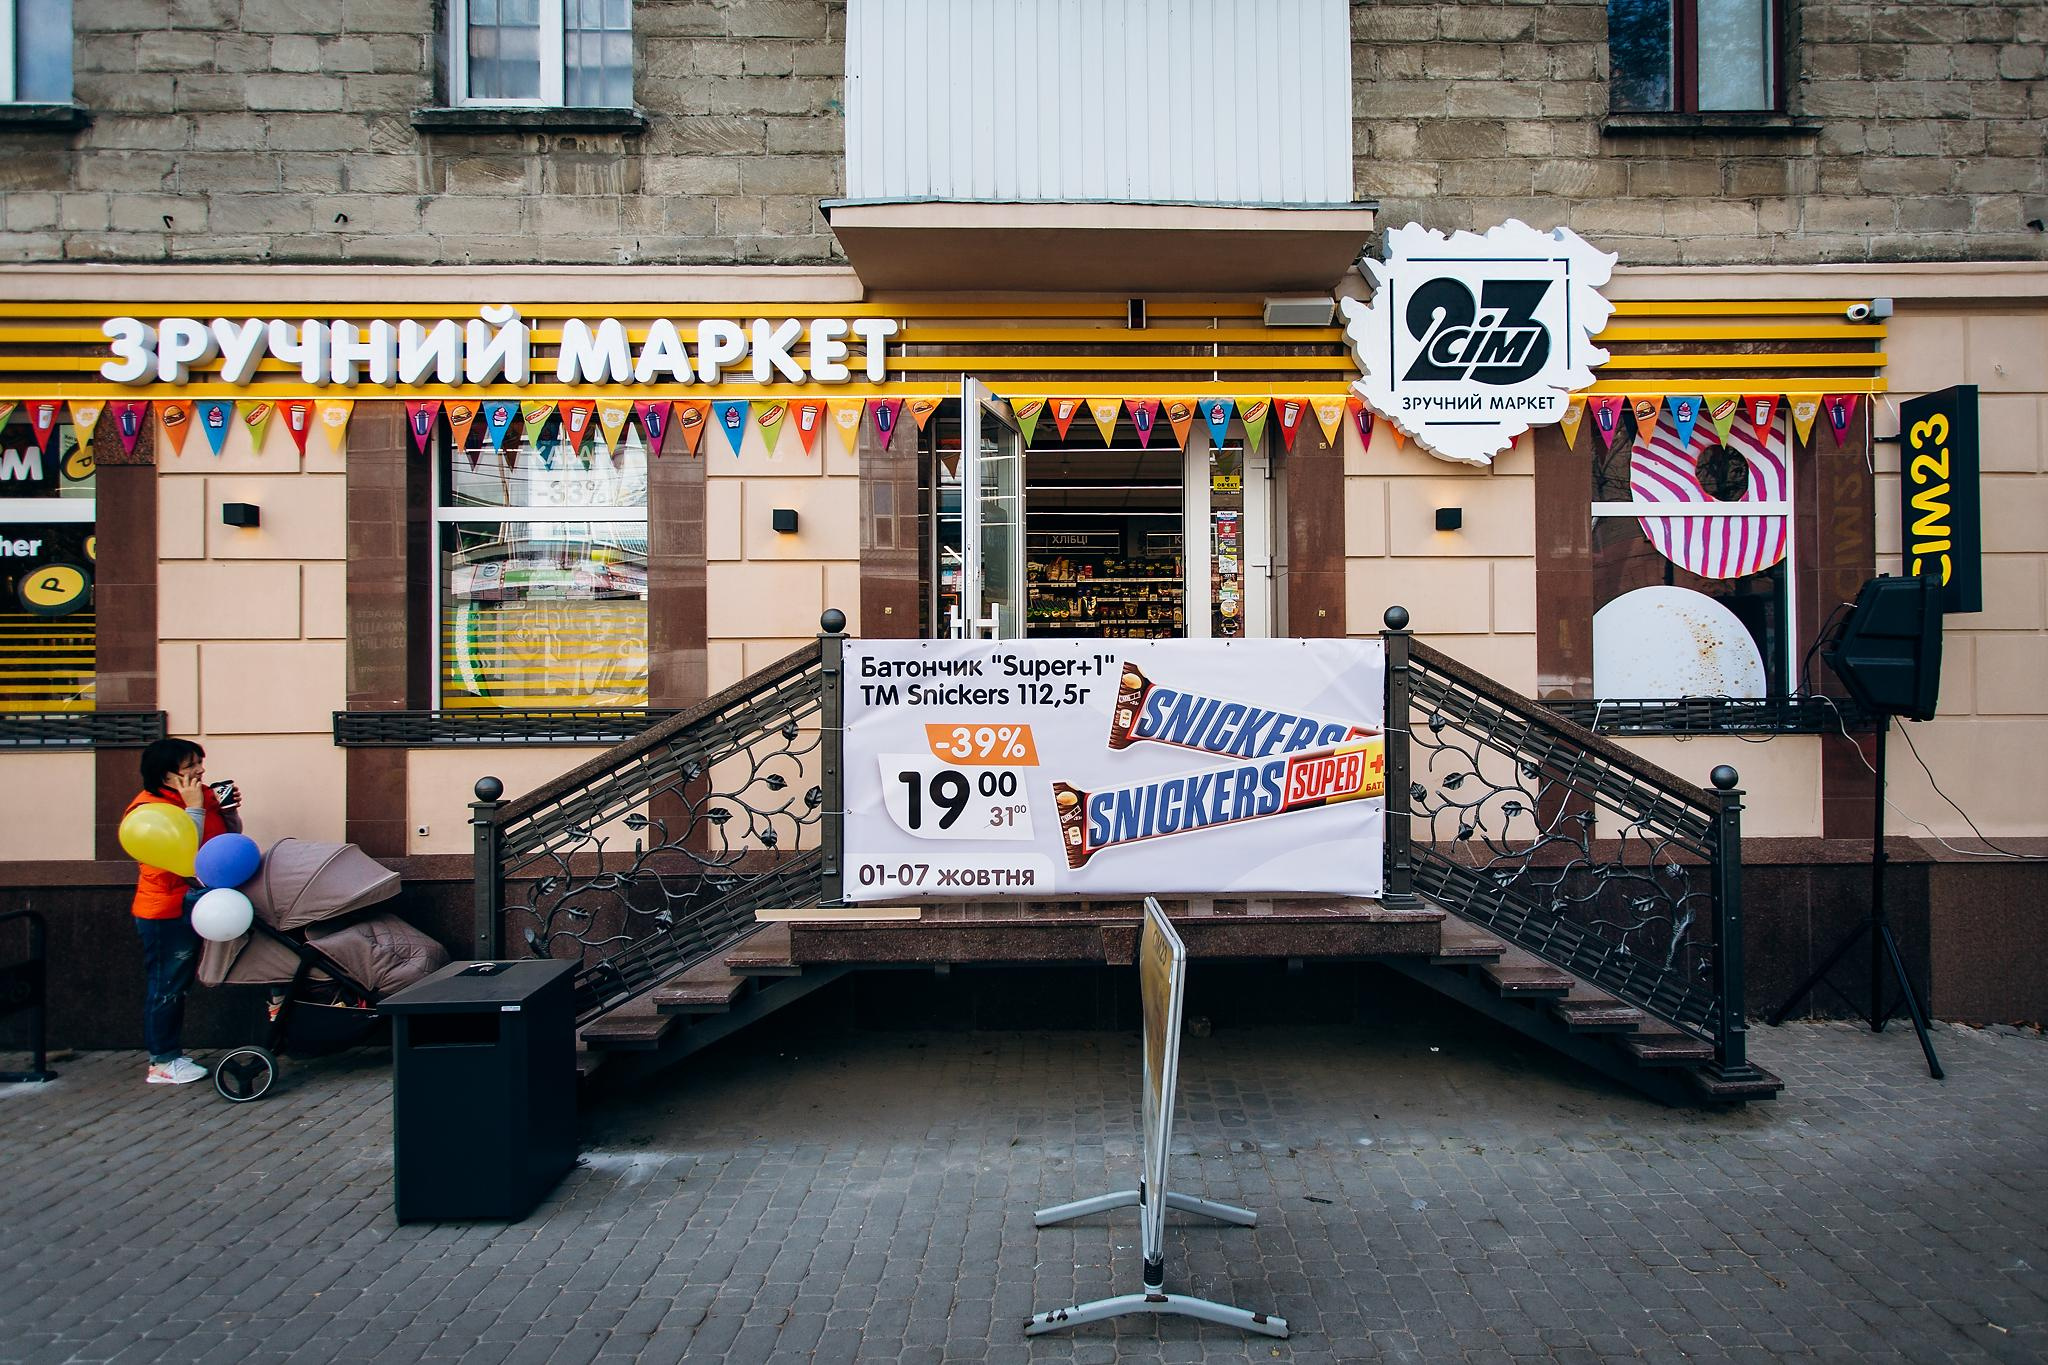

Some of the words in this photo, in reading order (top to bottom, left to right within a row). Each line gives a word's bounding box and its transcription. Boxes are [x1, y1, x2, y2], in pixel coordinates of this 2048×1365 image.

[101, 304, 529, 387] ЗРУЧНИЙ
[555, 317, 899, 386] МАРКЕТ
[1402, 277, 1553, 386] 23
[1402, 393, 1482, 411] ЗРУЧНИЙ
[1489, 396, 1556, 411] МАРКЕТ
[1052, 535, 1088, 545] ХЛІБЦІ
[861, 656, 983, 677] Батончик
[991, 654, 1115, 682] "Super+1"
[860, 684, 900, 706] ТМ
[907, 683, 1009, 706] Snickers
[1018, 683, 1091, 709] 112,5г
[935, 727, 1026, 758] -39%
[898, 769, 971, 830] 19
[1366, 781, 1384, 792] БАТ
[1088, 761, 1286, 848] SNICKERS
[1293, 755, 1360, 800] SUPER
[858, 863, 930, 886] 01-07
[936, 868, 1036, 887] жовтня
